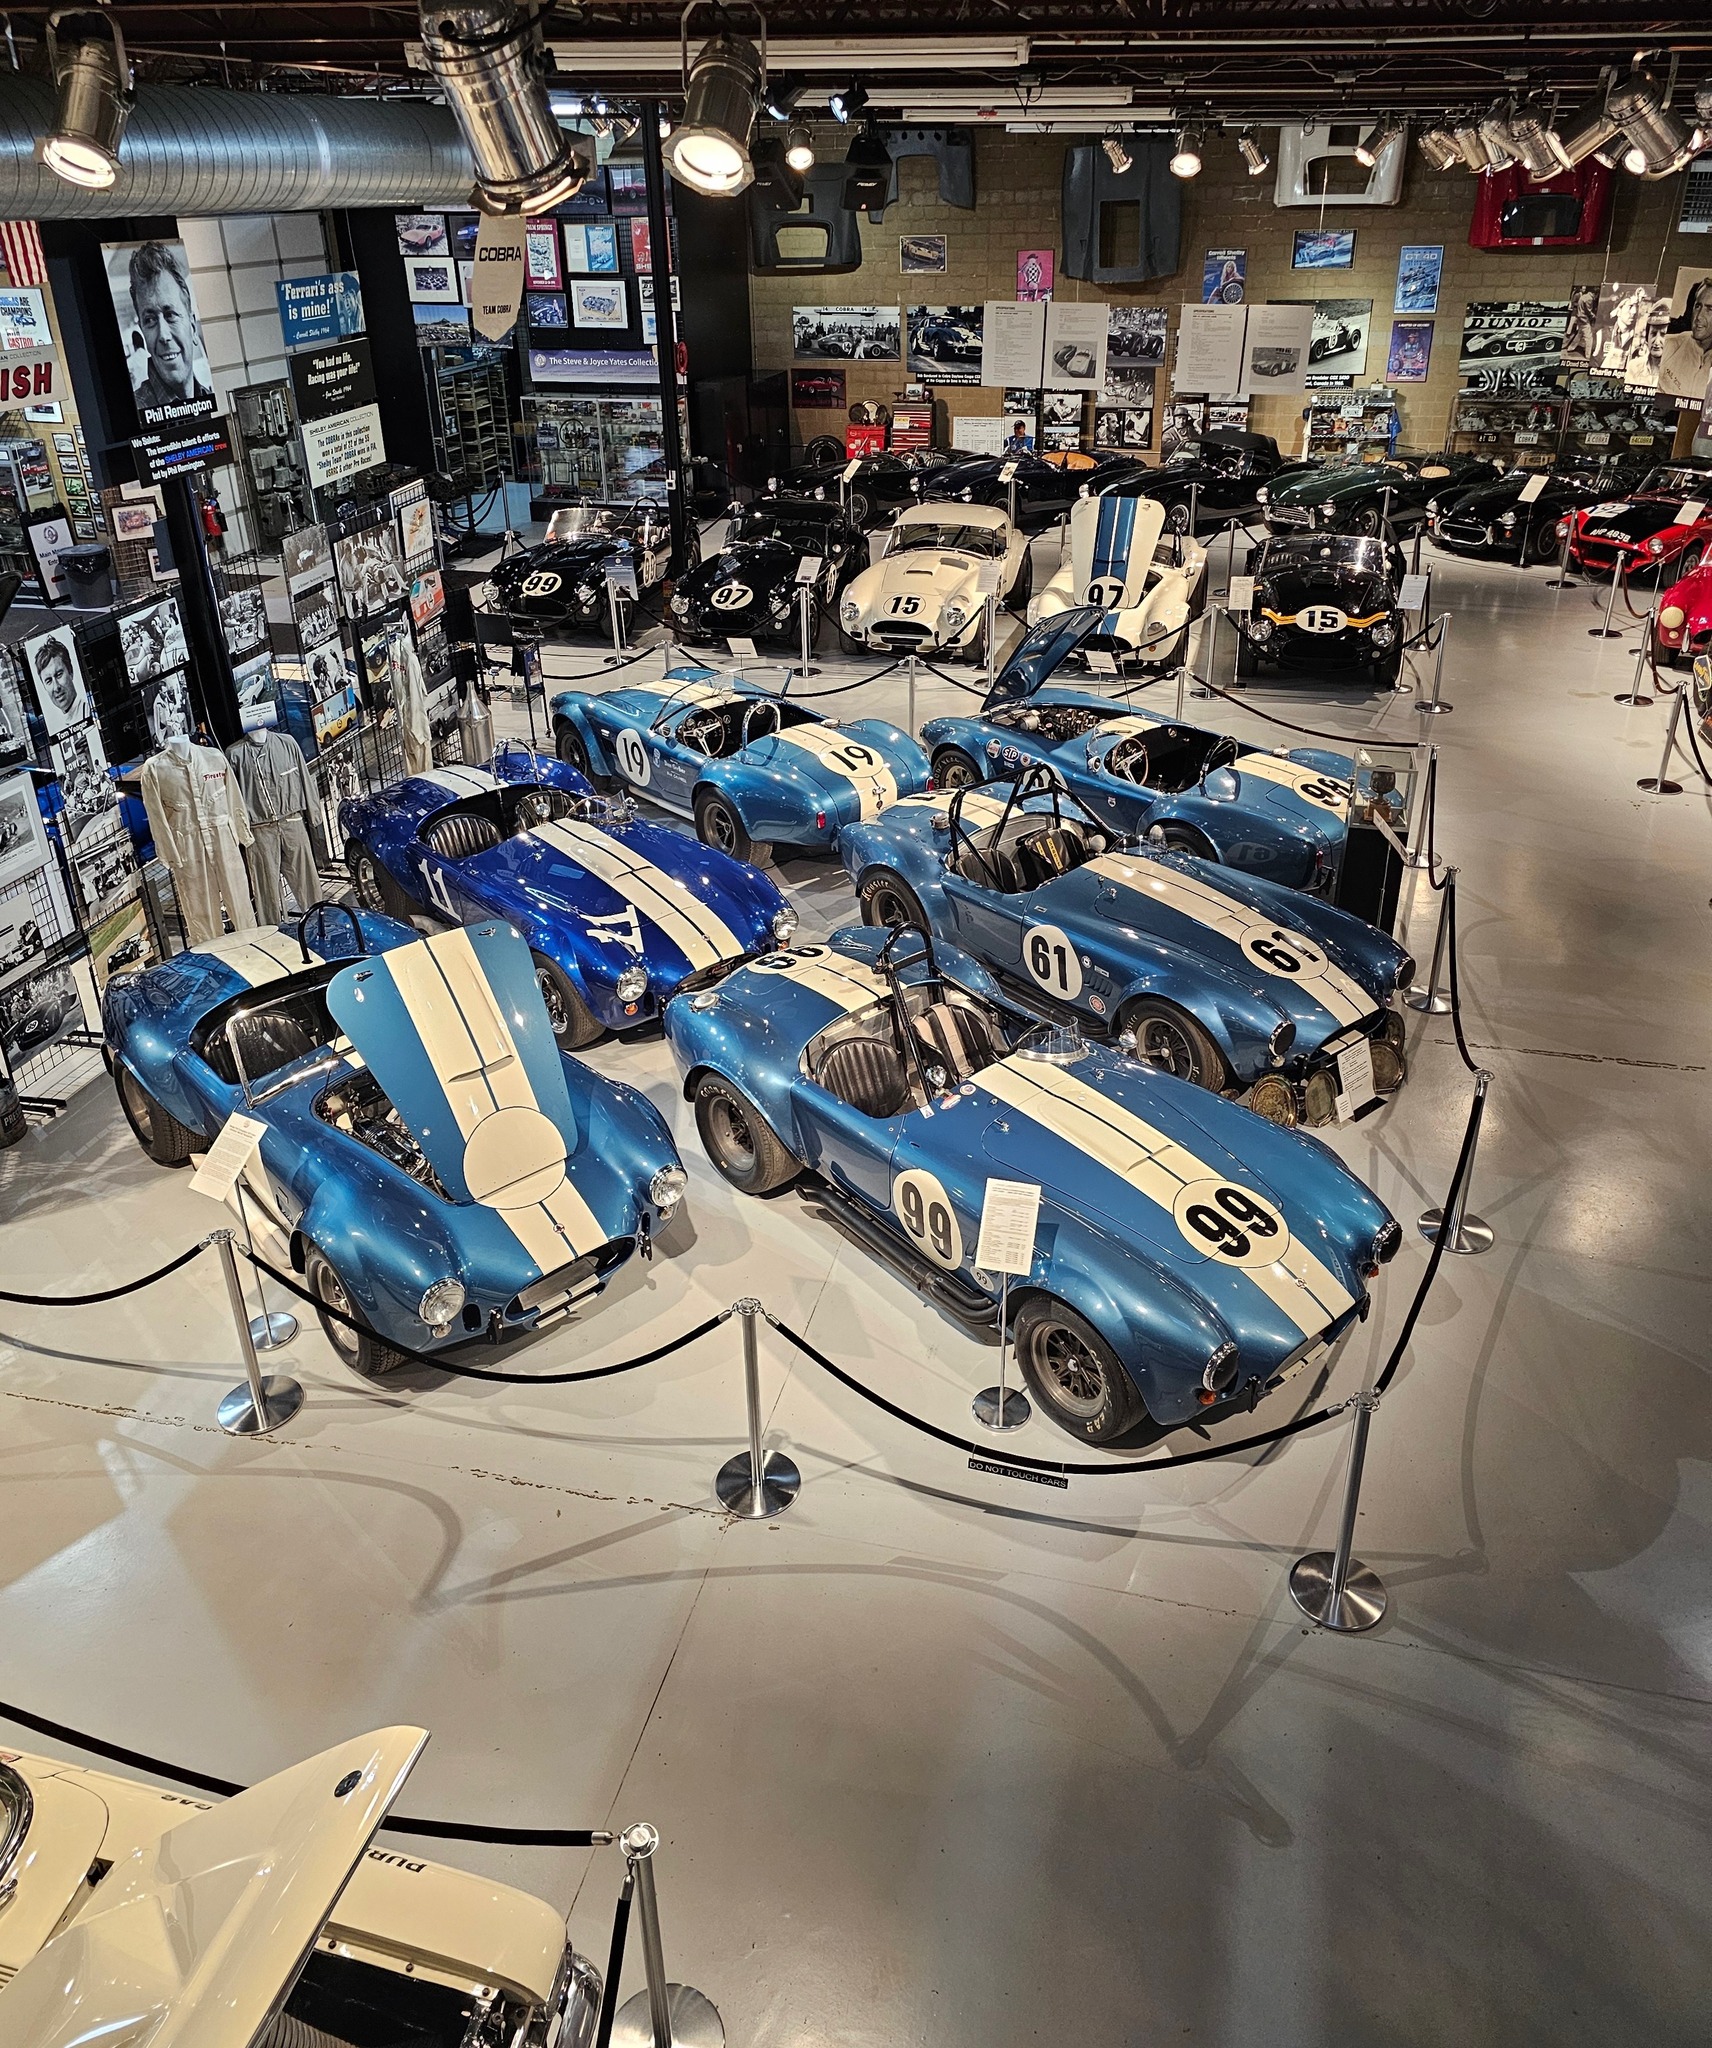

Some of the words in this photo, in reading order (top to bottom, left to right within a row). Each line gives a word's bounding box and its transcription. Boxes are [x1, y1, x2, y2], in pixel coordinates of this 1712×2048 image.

[479, 247, 521, 261] COBRA
[1423, 252, 1438, 260] 40
[328, 281, 344, 294] ass
[1, 307, 33, 316] CHAMPIONS
[288, 304, 298, 320] is
[483, 305, 496, 315] TEAM
[497, 304, 511, 314] COBRA
[1470, 317, 1552, 328] DUNLOP
[8, 337, 34, 348] CASTROL
[9, 350, 42, 360] COLLECTION
[549, 357, 562, 365] The
[563, 357, 582, 365] Steve
[590, 358, 609, 366] Joyce
[610, 358, 628, 366] Yates
[326, 370, 337, 381] was
[1589, 368, 1611, 376] Charlie
[1634, 387, 1647, 395] John
[1675, 398, 1688, 409] Phil
[145, 406, 164, 424] Phil
[163, 400, 213, 420] Remington
[309, 425, 328, 436] SHELBY
[327, 418, 350, 431] AMERICAN
[349, 411, 374, 424] COLLECTION
[146, 447, 157, 457] The
[164, 452, 186, 465] SHELBY
[186, 444, 215, 460] AMERICAN
[22, 464, 31, 472] 24
[167, 465, 178, 476] Phil
[39, 549, 53, 559] Main
[525, 575, 556, 592] 99
[715, 588, 748, 605] 97
[1087, 584, 1124, 609] 97
[890, 597, 919, 613] 15
[1305, 610, 1339, 628] 15
[57, 731, 69, 741] Tom
[68, 721, 88, 734] Yeager
[623, 738, 644, 778] 19
[829, 745, 873, 772] 19
[1003, 748, 1018, 760] STP
[418, 858, 463, 926] 11
[862, 880, 889, 901] Hoosier
[580, 904, 645, 954] 11
[1250, 932, 1319, 973] 61
[1031, 936, 1068, 992] 61
[902, 1181, 953, 1260] 99
[1186, 1188, 1278, 1257] 99
[969, 1461, 984, 1470] DO
[985, 1463, 1004, 1475] NOT
[1007, 1468, 1039, 1482] TOUCH
[1040, 1476, 1067, 1488] CARS
